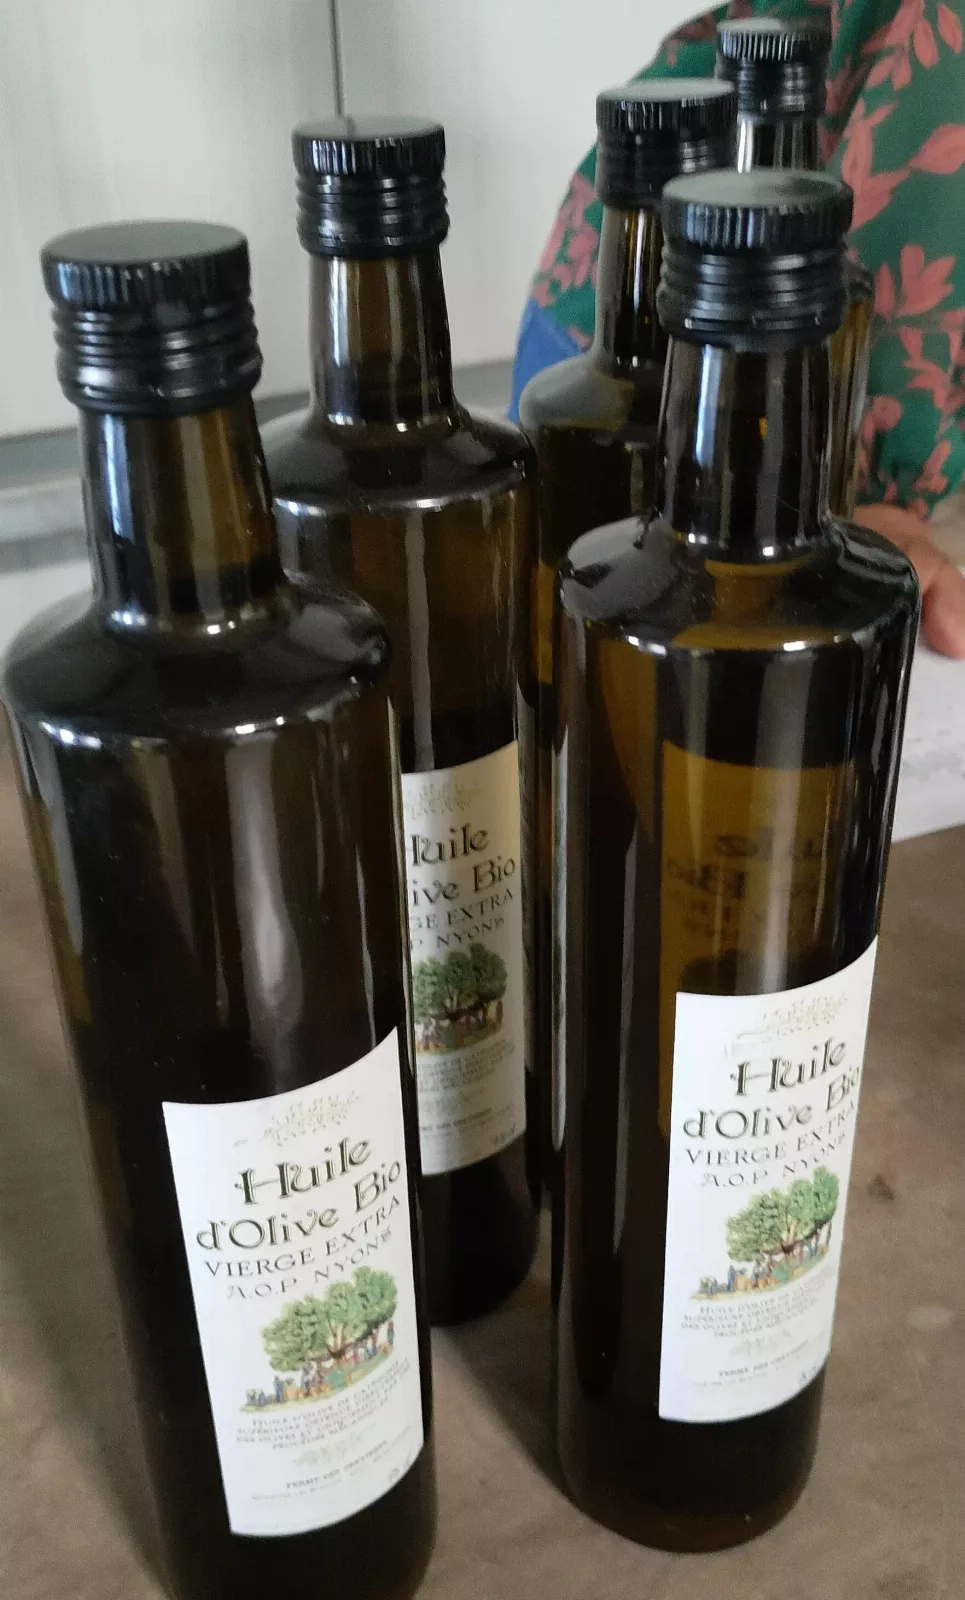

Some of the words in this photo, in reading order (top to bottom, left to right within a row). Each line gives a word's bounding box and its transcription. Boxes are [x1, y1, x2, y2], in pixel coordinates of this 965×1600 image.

[472, 855, 515, 893] Bio
[447, 887, 514, 925] EXTRA
[730, 1035, 846, 1096] Huile
[683, 1104, 812, 1139] d'Olive
[234, 1136, 372, 1205] Huile
[685, 1142, 786, 1165] VIERGE
[196, 1207, 339, 1250] d'Olive
[353, 1160, 400, 1213] Bio
[204, 1247, 315, 1277] VIERGE
[325, 1195, 400, 1256] EXTRA
